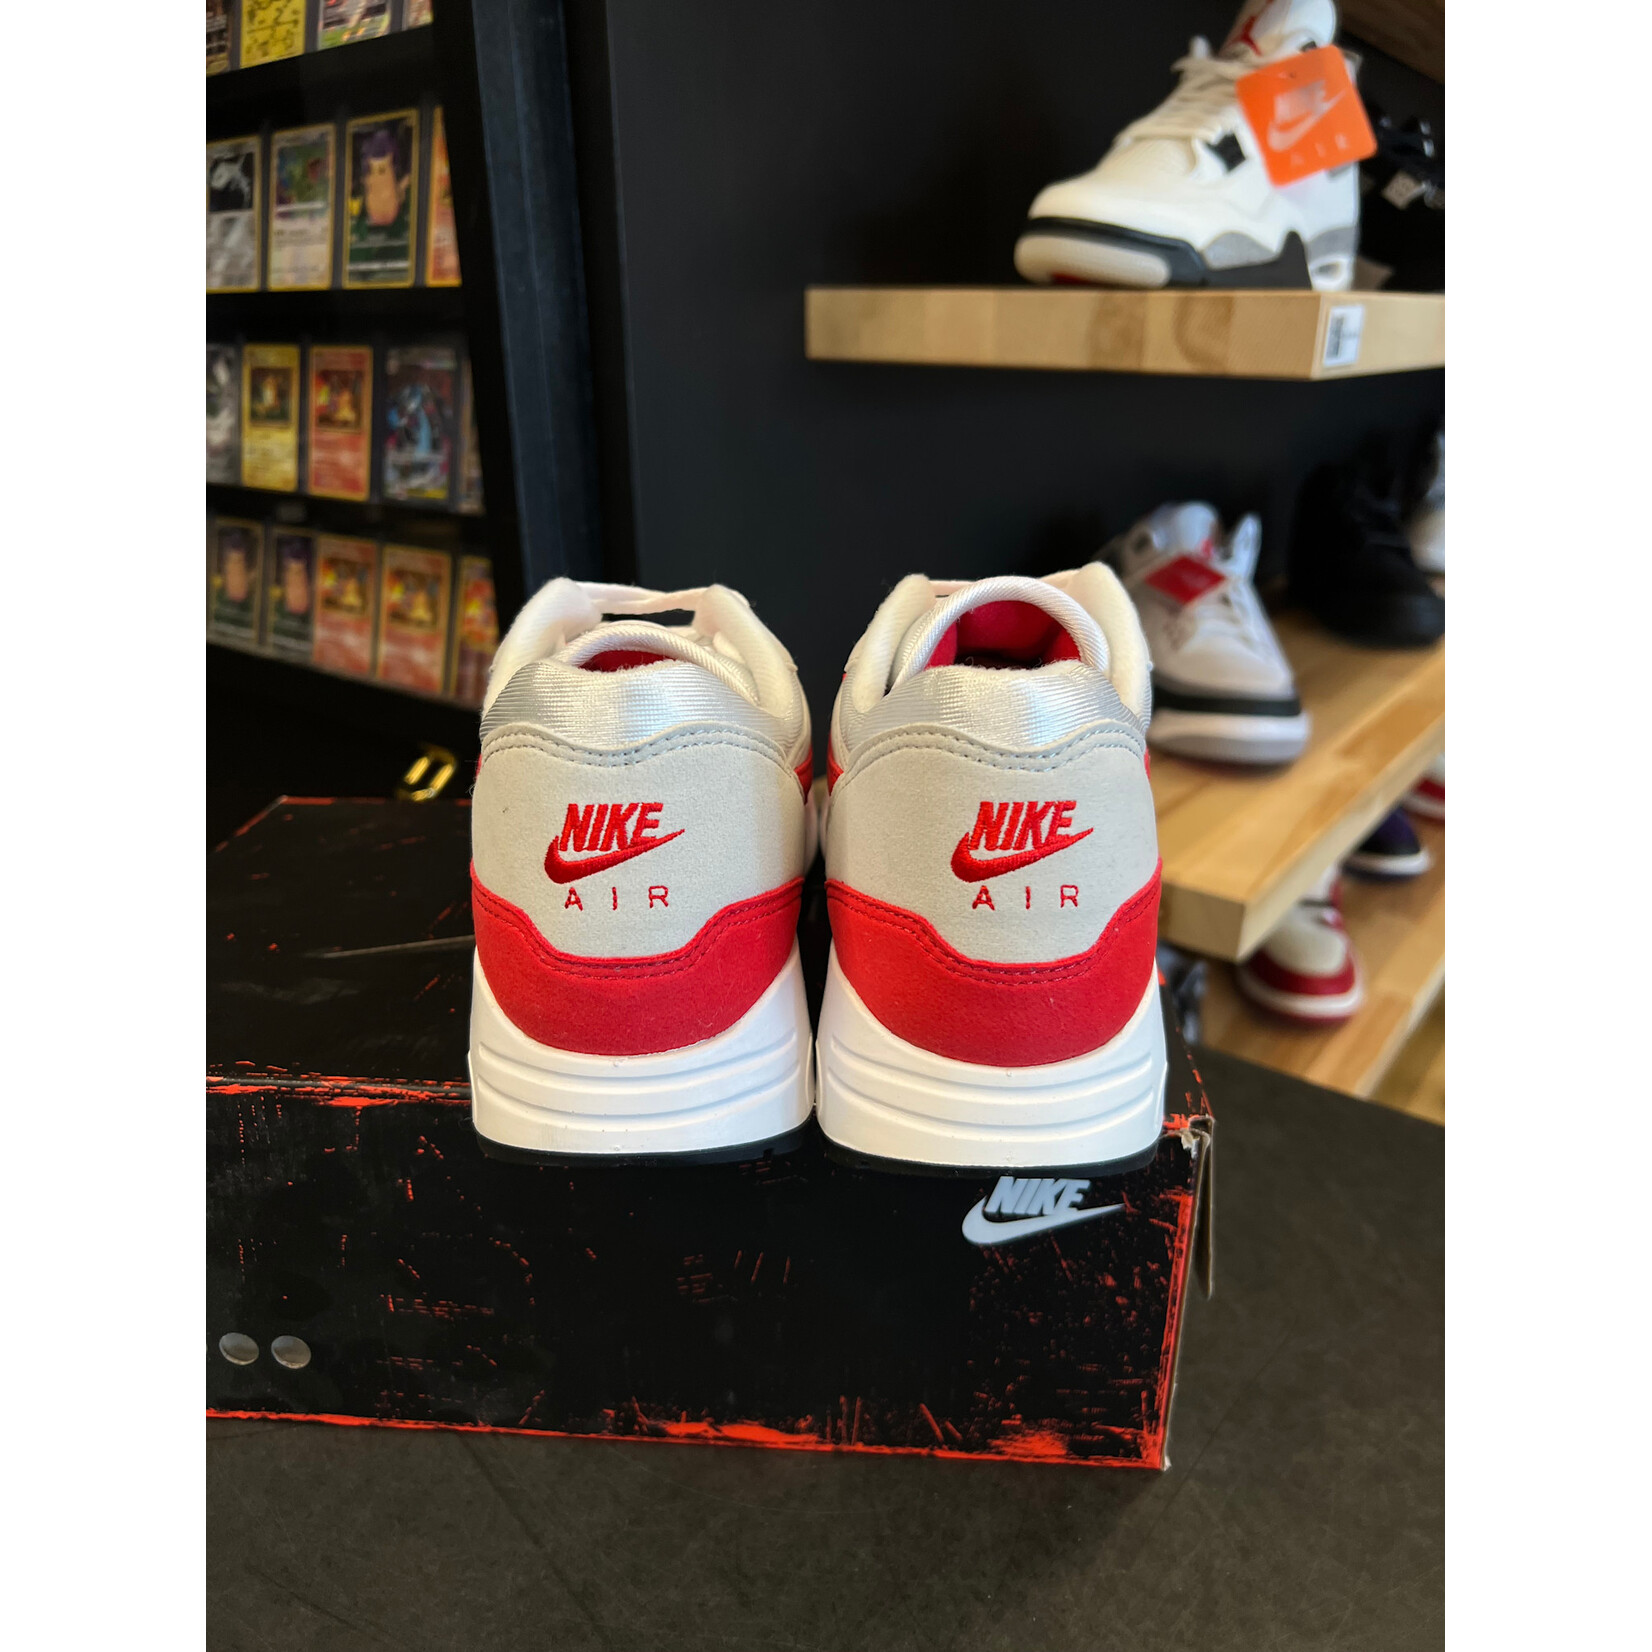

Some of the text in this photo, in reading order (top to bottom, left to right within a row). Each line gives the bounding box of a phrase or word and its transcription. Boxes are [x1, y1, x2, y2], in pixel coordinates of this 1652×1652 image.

[558, 802, 664, 852] NIKE
[967, 800, 1077, 851] NIKE
[564, 886, 669, 911] AIR
[971, 885, 1079, 911] AIR
[984, 1175, 1091, 1216] NIKE
